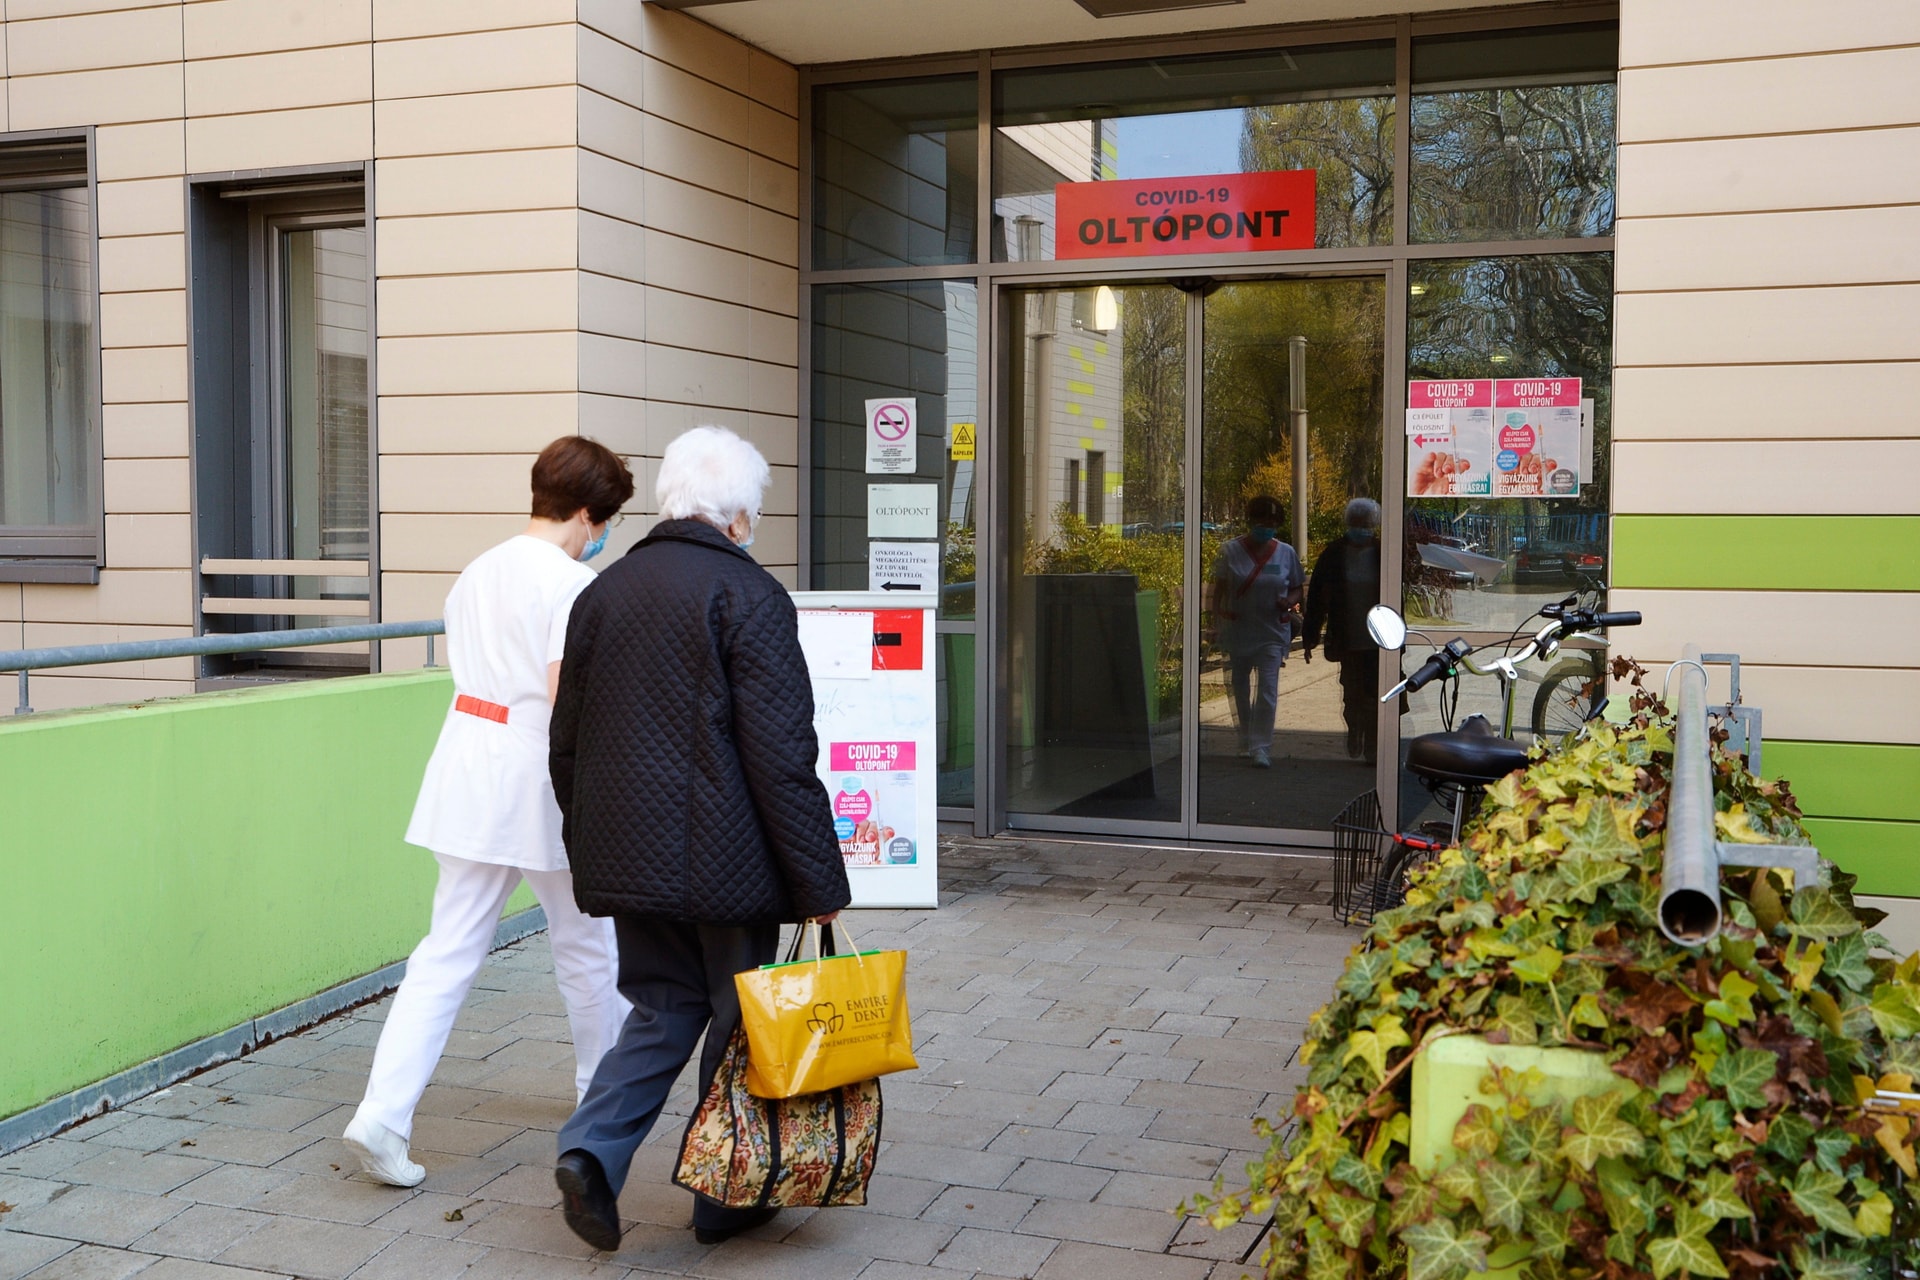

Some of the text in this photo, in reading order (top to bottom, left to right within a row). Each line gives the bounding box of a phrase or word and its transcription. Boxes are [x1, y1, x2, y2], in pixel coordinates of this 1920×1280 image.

[1135, 187, 1230, 207] COVID-19
[1077, 208, 1290, 246] OLTÓPONT
[1427, 382, 1475, 397] COVID-19
[1513, 381, 1562, 397] COVID-19
[1433, 397, 1468, 408] OLTÓPONT
[1519, 396, 1555, 407] OLTÓPONT
[1421, 412, 1444, 420] ÉPÜLET
[1497, 472, 1539, 483] VIGYÁZZUNK
[1498, 483, 1539, 494] EGYMÁSRA!
[875, 505, 931, 516] OLTÓPONT
[848, 744, 898, 760] COVID-19
[855, 760, 891, 771] OLTÓPONT
[840, 841, 877, 853] GYÁZZUNK
[842, 853, 876, 864] YMÁSRA!
[846, 994, 889, 1011] EMPIRE
[854, 1007, 886, 1023] DENT
